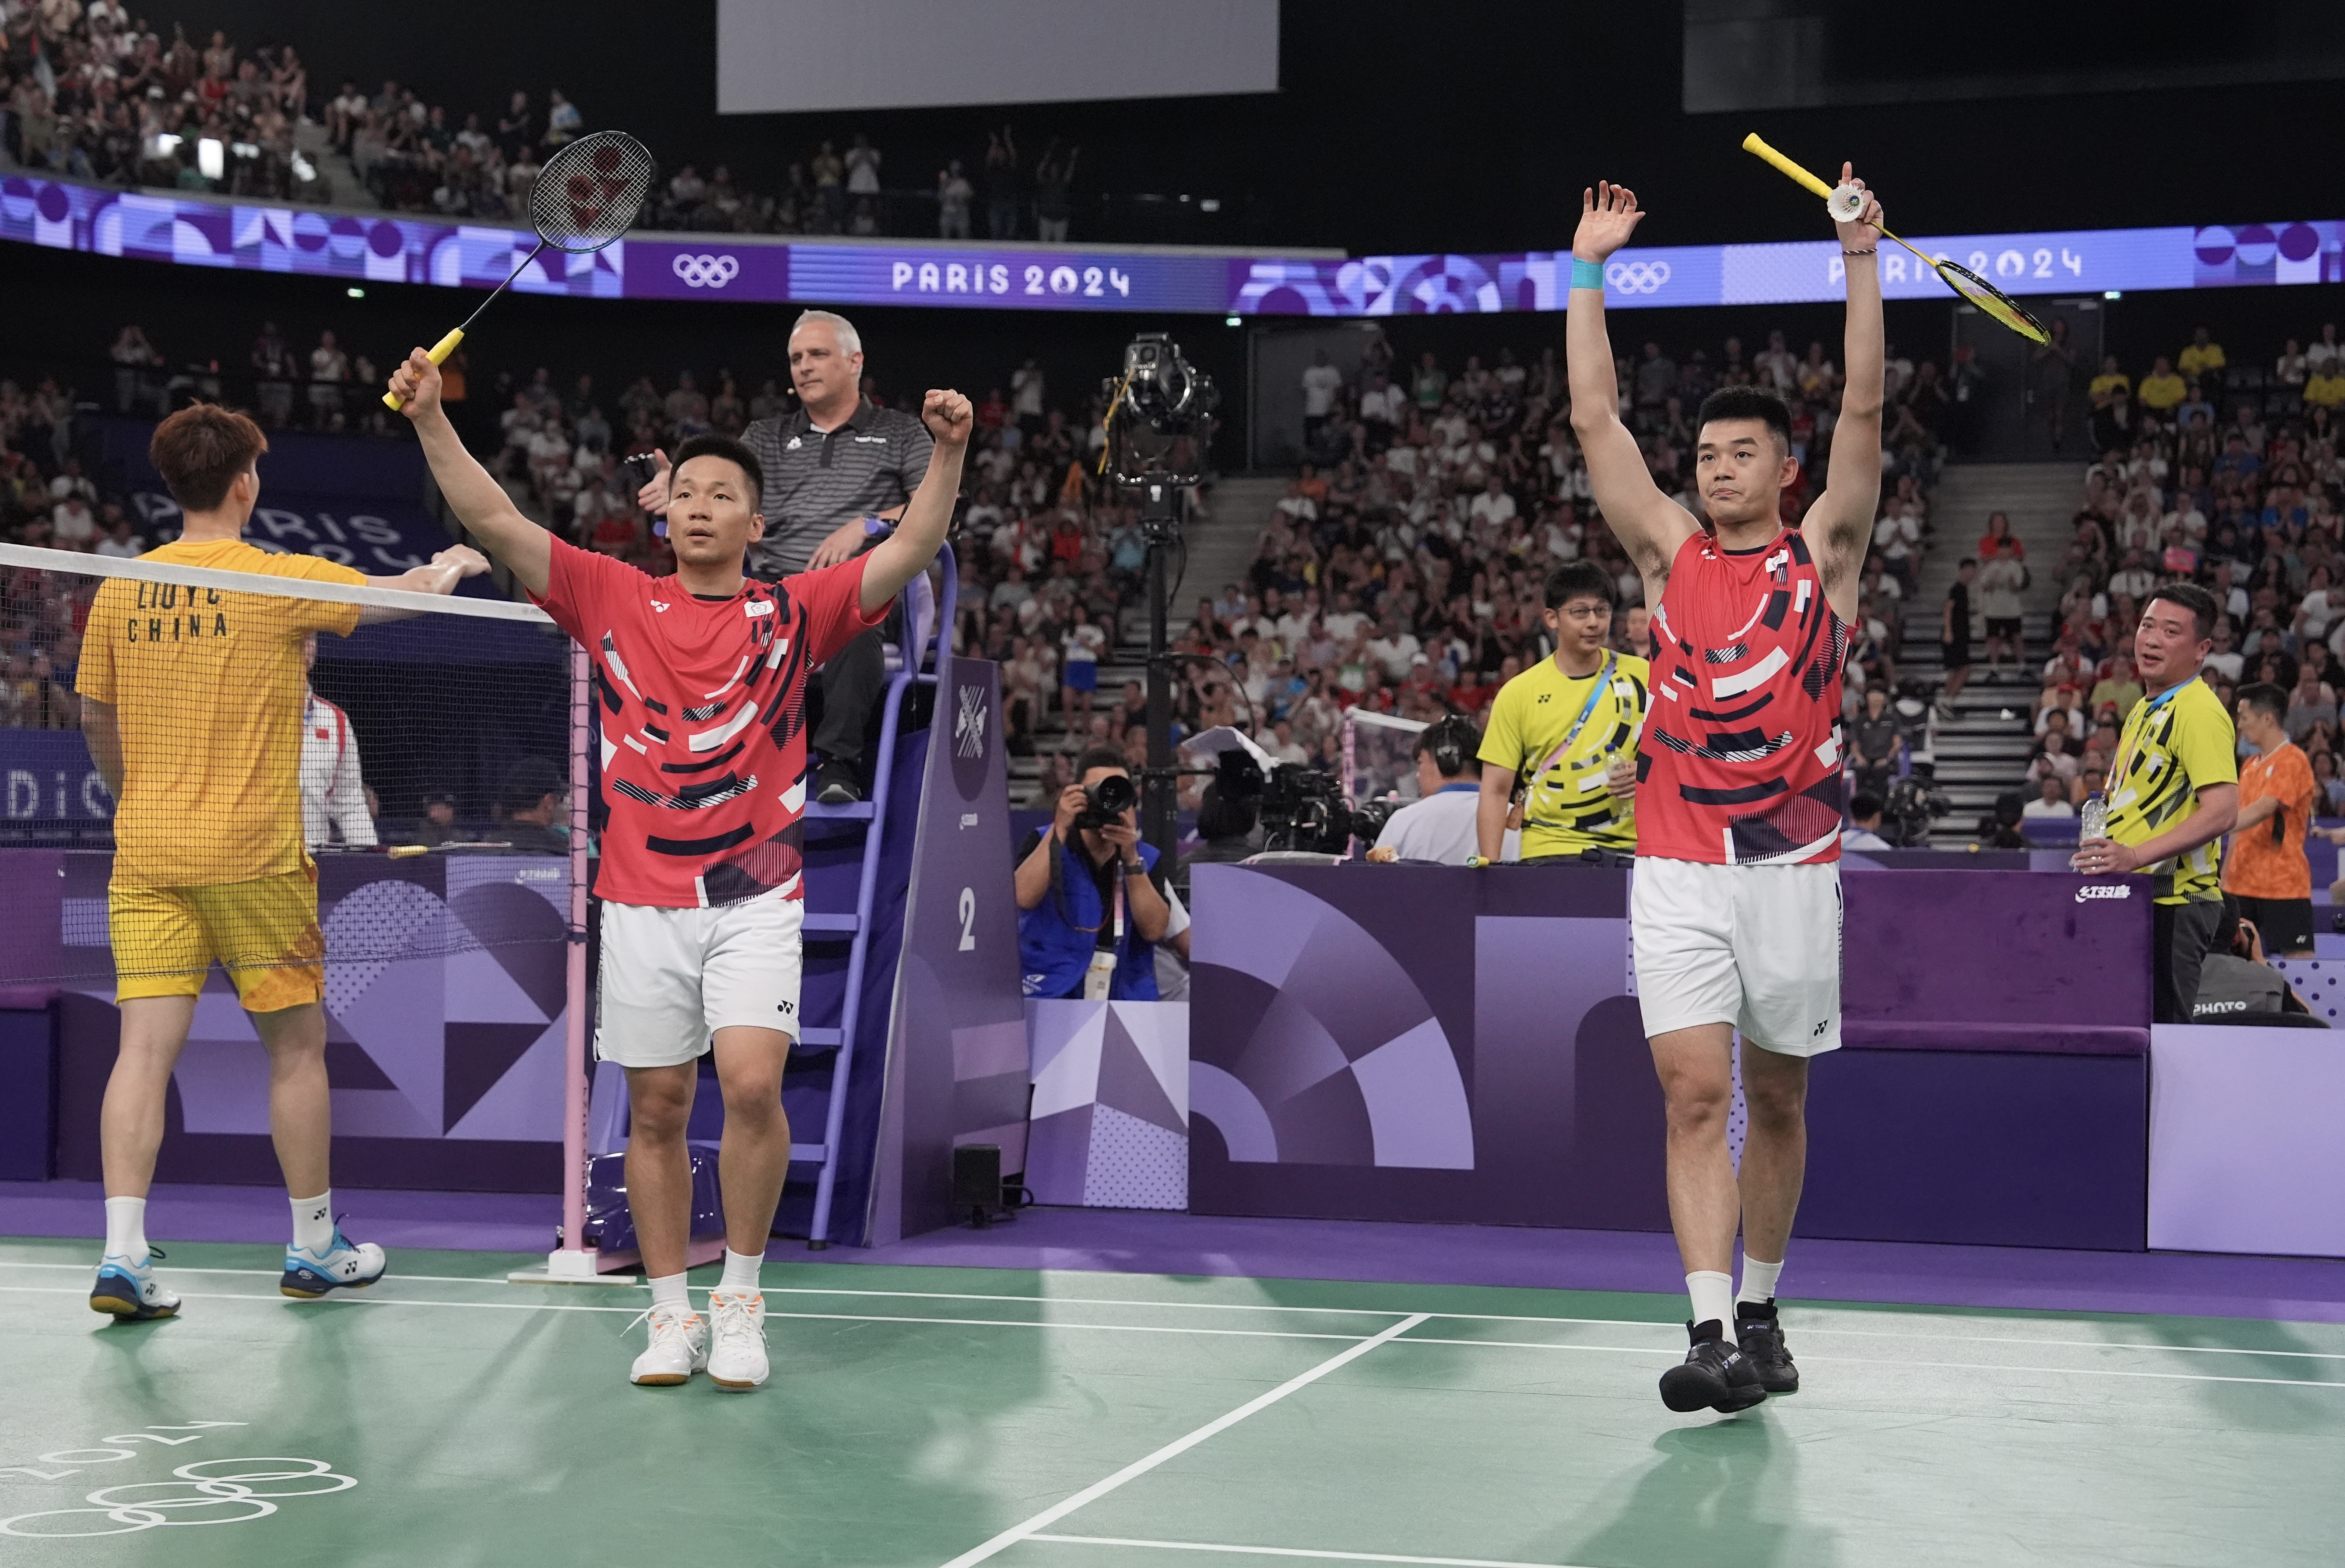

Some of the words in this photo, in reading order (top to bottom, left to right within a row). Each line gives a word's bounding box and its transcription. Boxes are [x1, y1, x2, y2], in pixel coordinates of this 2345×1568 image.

[892, 261, 1010, 295] PARIS
[1024, 264, 1130, 297] 2024
[1828, 251, 1950, 285] PRIS
[1967, 248, 2082, 279] 2024
[128, 613, 226, 642] CHINA
[958, 887, 976, 951] 2
[2193, 1000, 2247, 1017] PHOTO
[1727, 1351, 1742, 1365] YONEX
[0, 1421, 250, 1480] 2024
